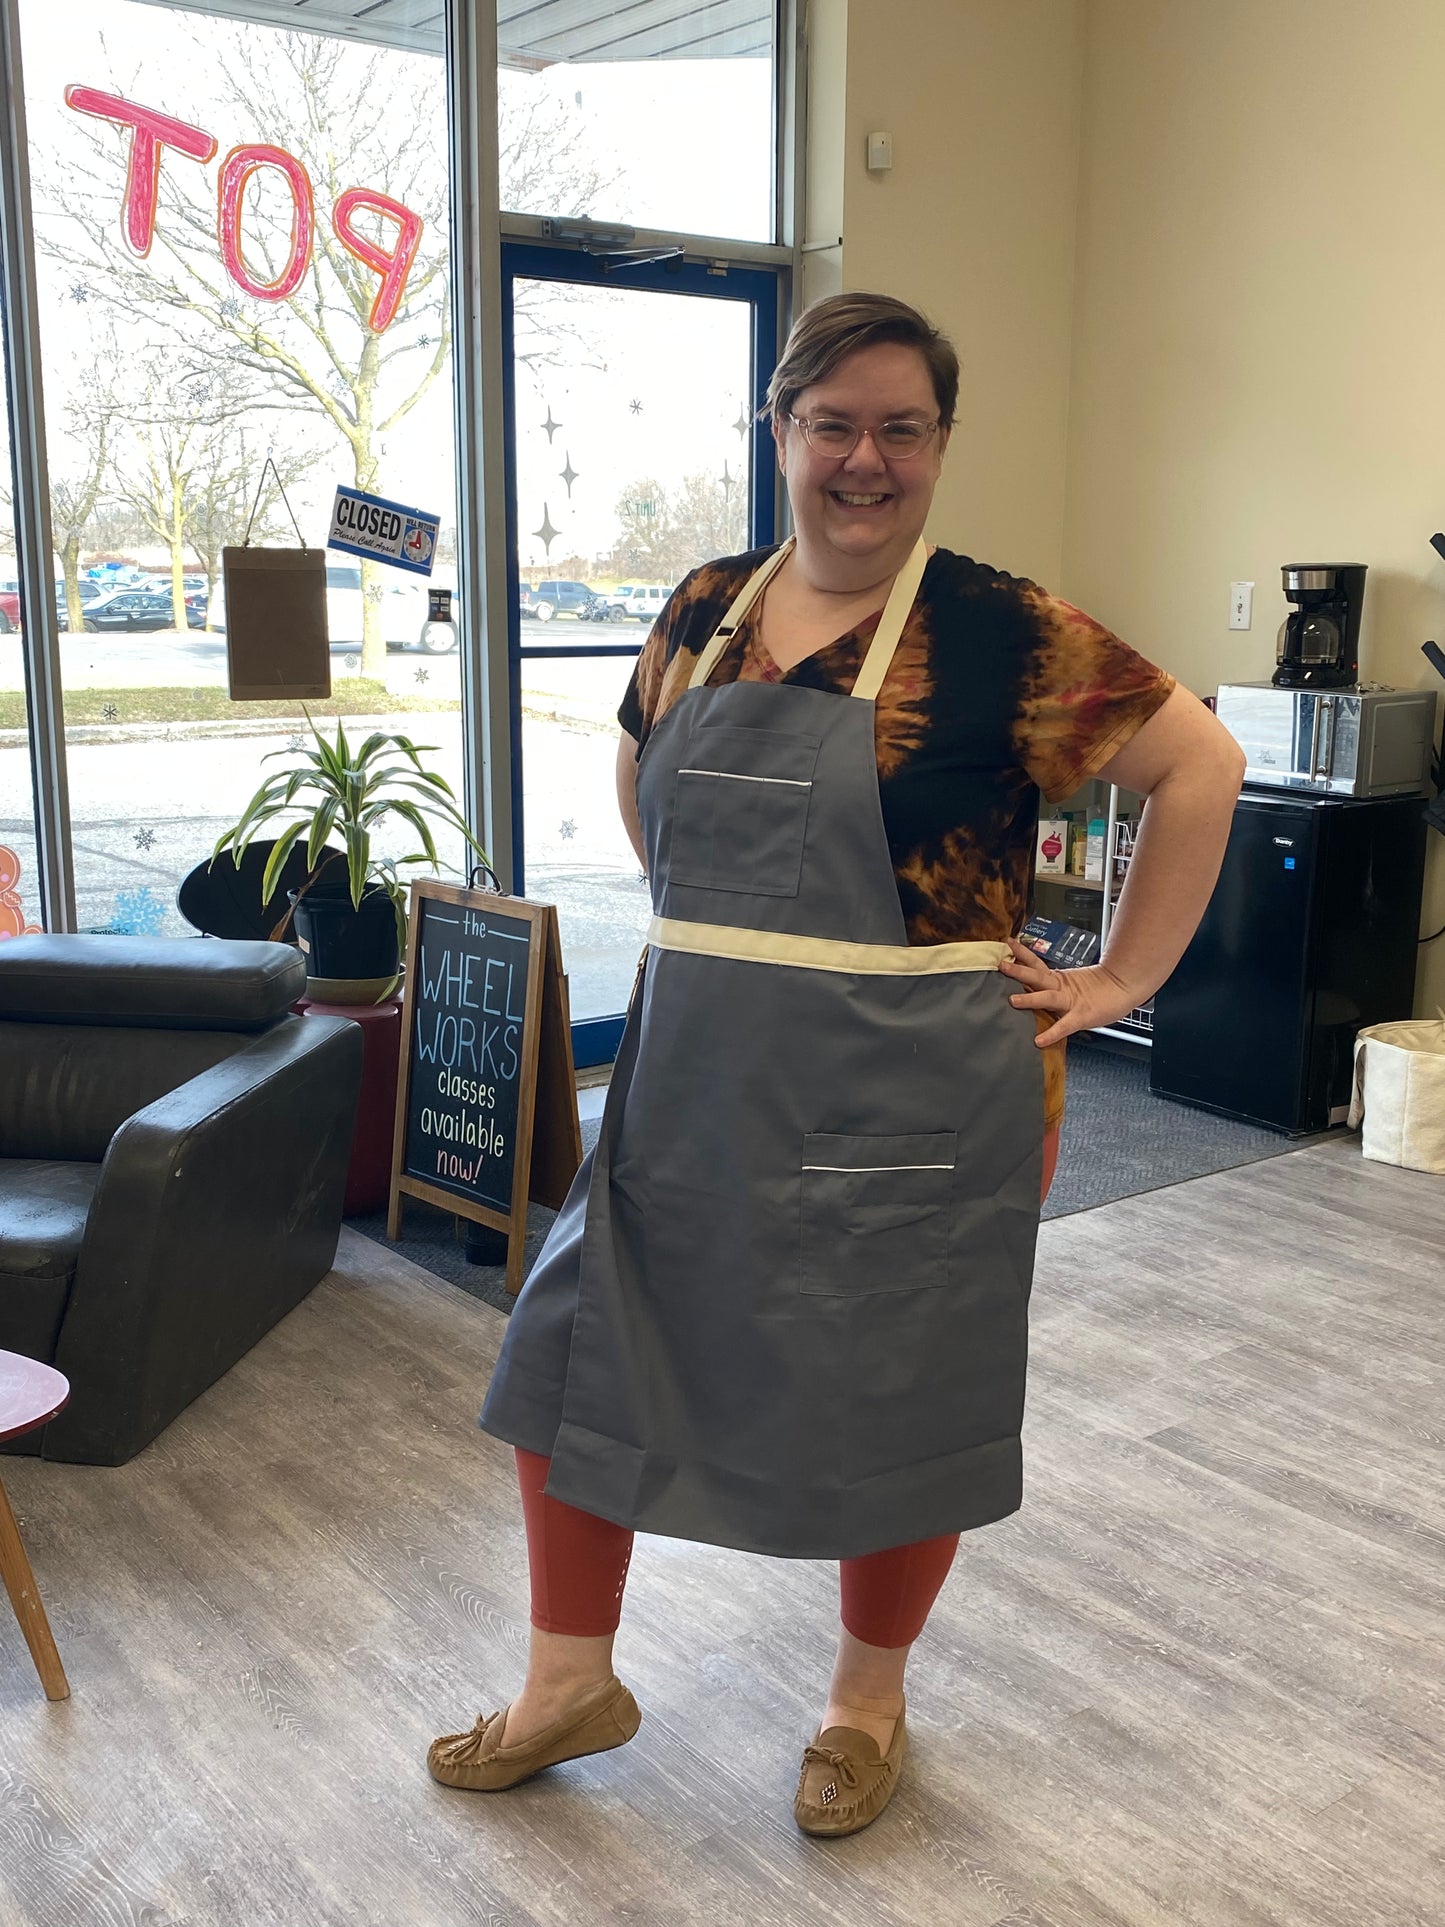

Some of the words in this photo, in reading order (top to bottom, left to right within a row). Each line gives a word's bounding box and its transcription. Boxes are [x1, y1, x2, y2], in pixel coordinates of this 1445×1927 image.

[333, 528, 356, 541] Please
[357, 536, 375, 546] Call
[374, 542, 396, 553] Again
[337, 498, 401, 541] CLOSED
[463, 911, 487, 939] the
[1025, 923, 1048, 938] Cutlery
[421, 945, 523, 1023] WHEEL
[417, 1007, 519, 1081] WORKS
[438, 1067, 496, 1110] classes
[421, 1106, 505, 1158] available
[437, 1149, 484, 1185] now!
